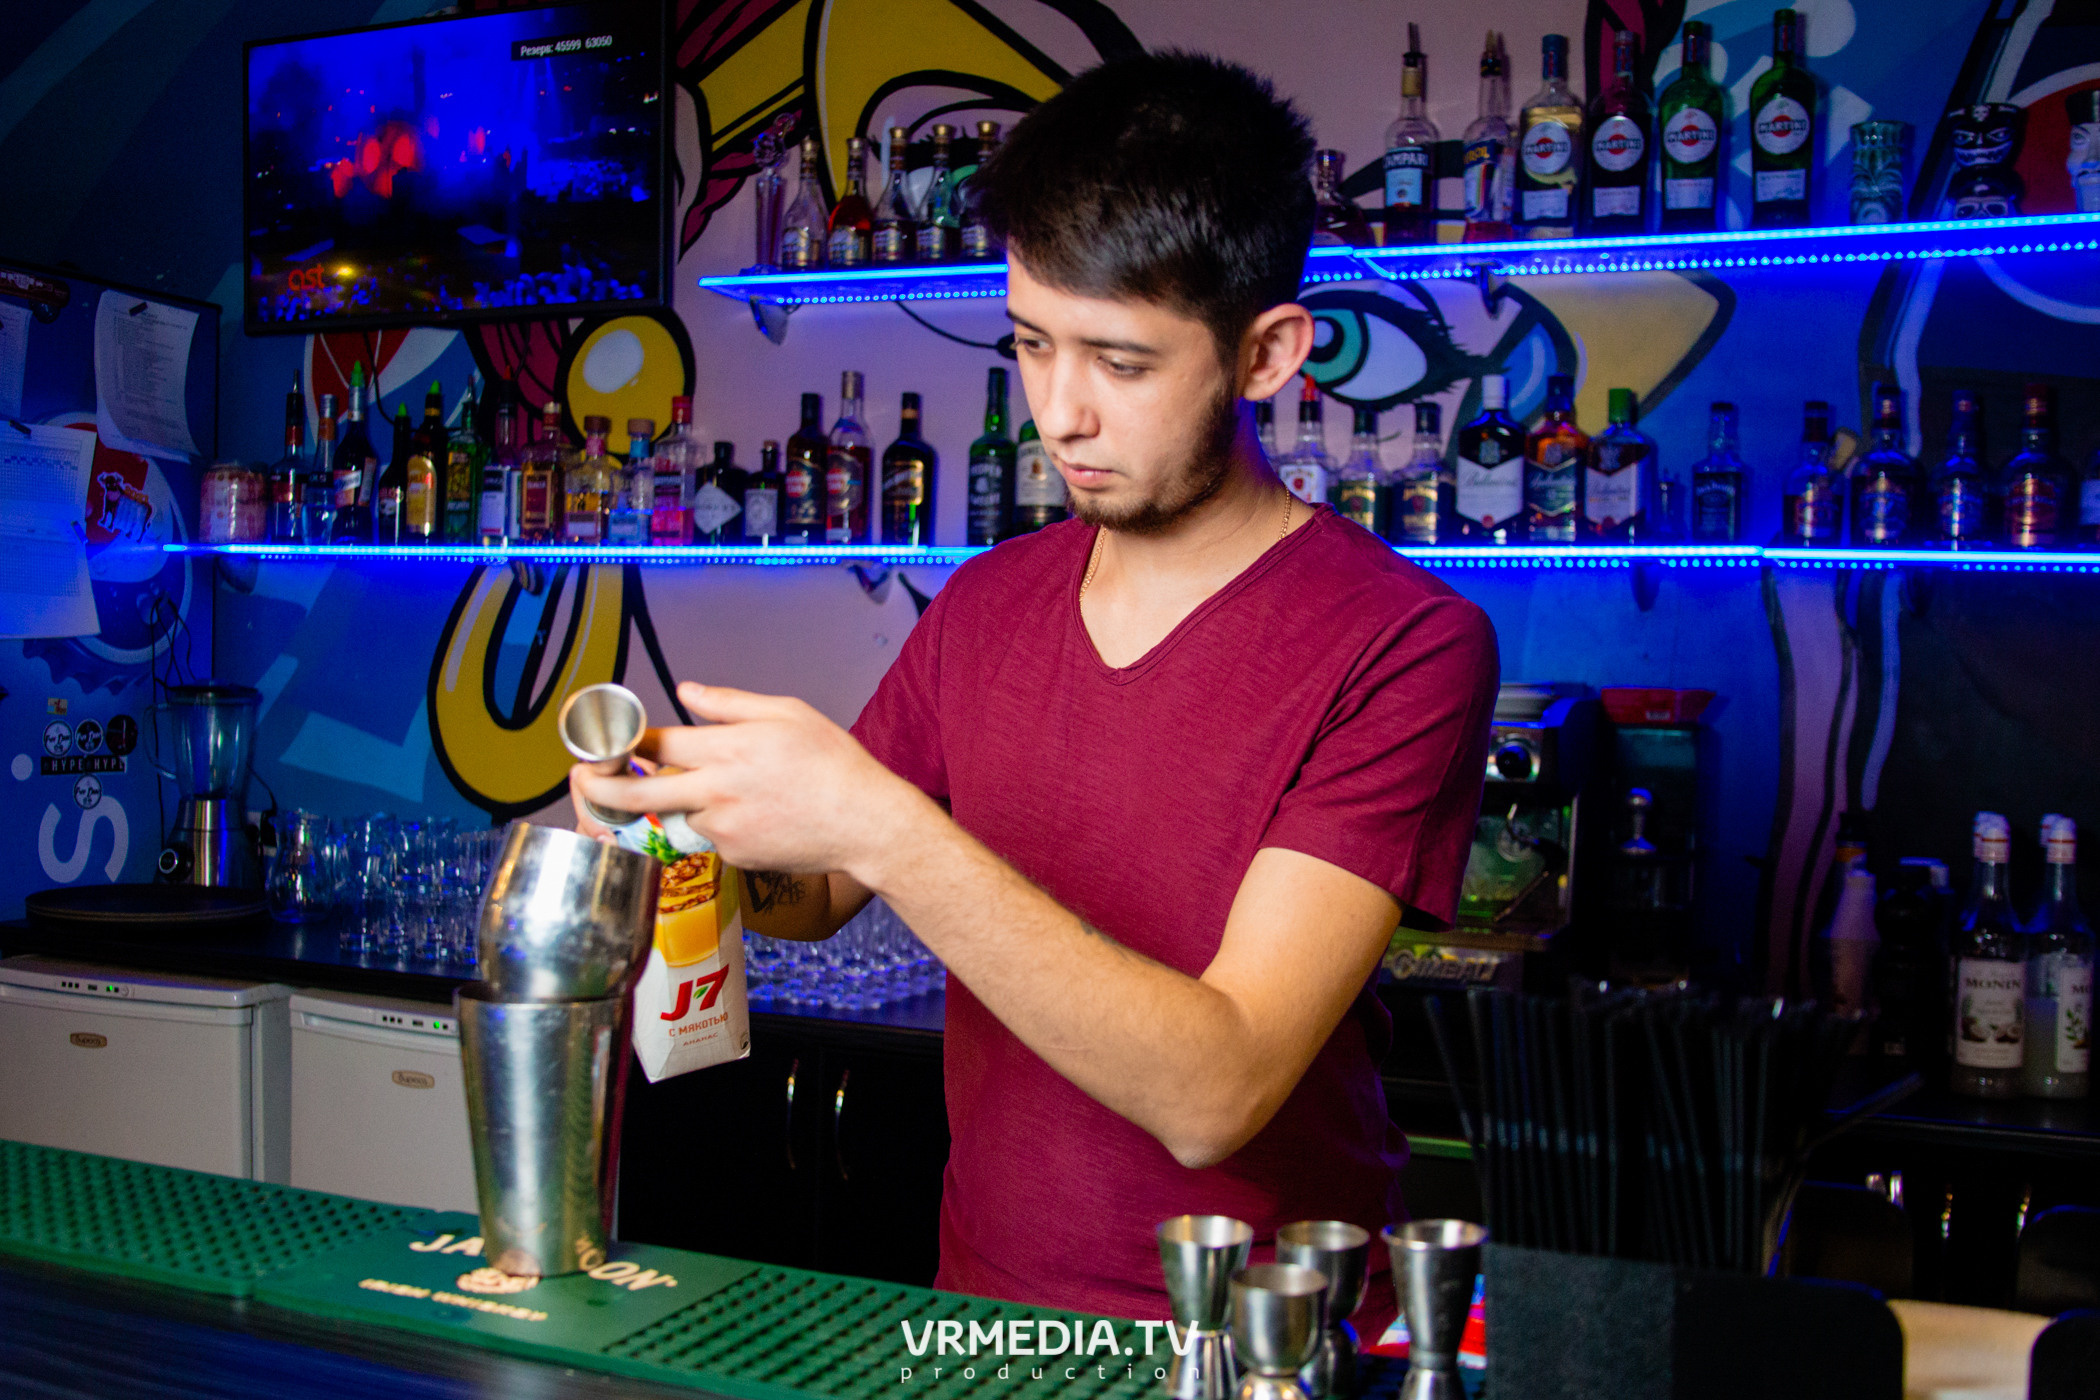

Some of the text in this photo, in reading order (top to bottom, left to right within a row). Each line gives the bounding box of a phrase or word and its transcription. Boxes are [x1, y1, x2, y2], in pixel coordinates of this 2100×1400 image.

[554, 39, 582, 53] 45599
[585, 35, 613, 49] 63050
[1758, 119, 1808, 134] MARTINI
[1666, 129, 1716, 144] MARTINI
[1596, 138, 1642, 152] MARTINI
[52, 758, 84, 772] HYPE
[1965, 978, 2021, 990] MONIN
[660, 963, 730, 1022] J7
[669, 1011, 729, 1037] С МЯКОТЬЮ
